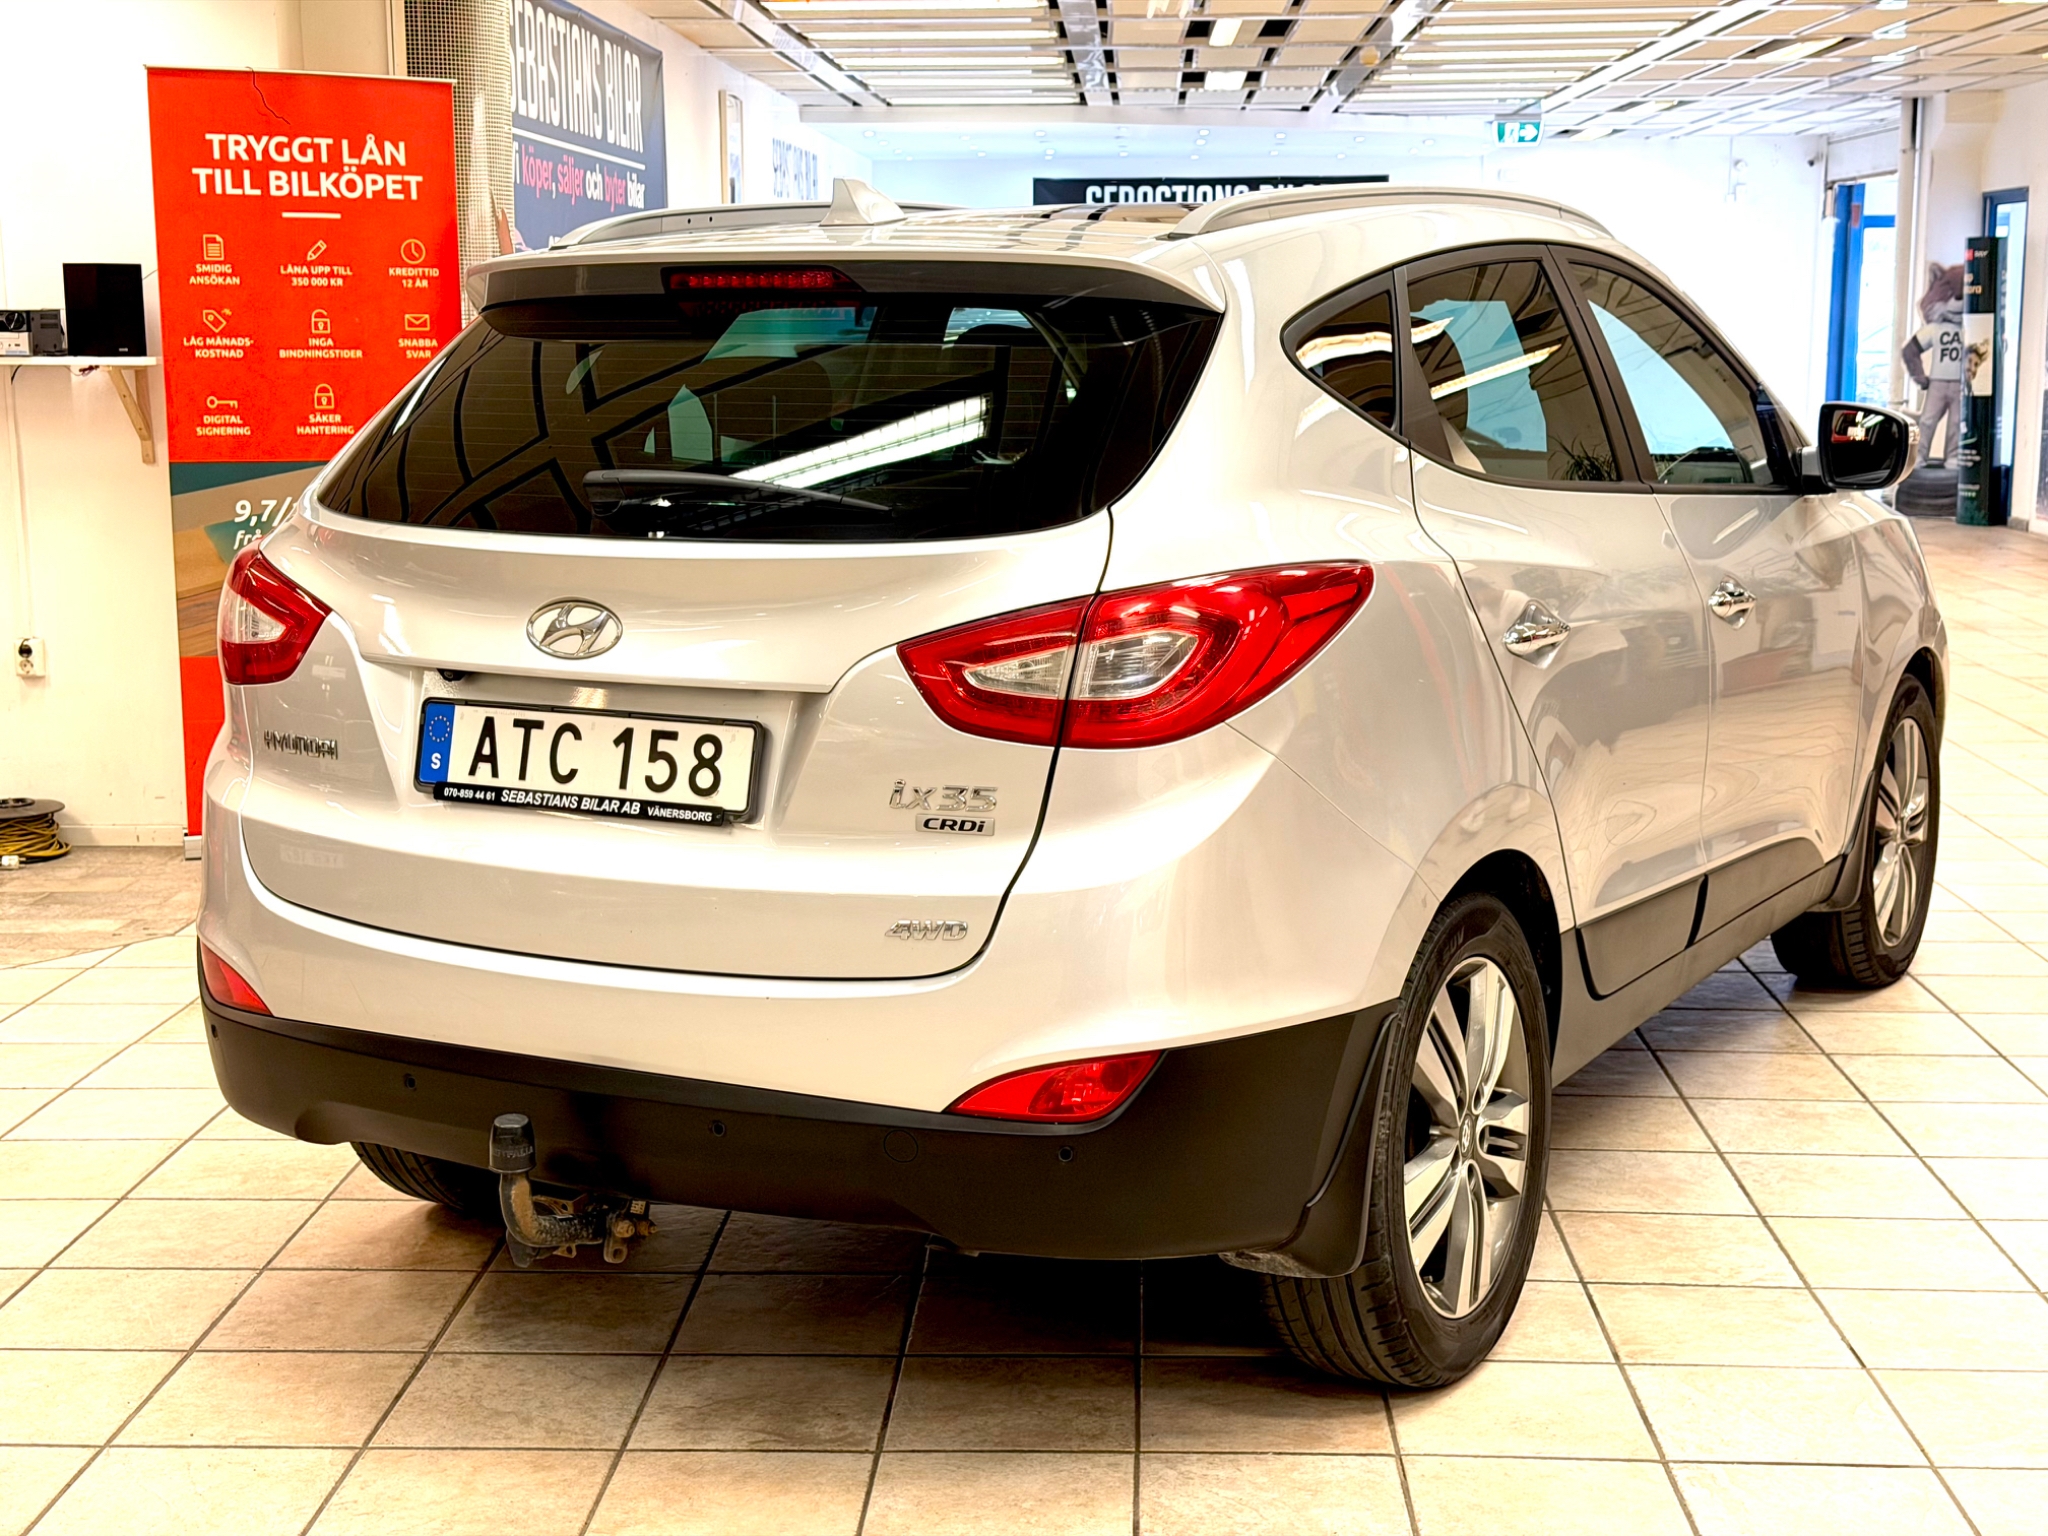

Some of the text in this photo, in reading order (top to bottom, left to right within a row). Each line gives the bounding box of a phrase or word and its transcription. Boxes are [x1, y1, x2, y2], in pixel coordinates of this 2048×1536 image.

[604, 39, 643, 153] BILAR
[205, 133, 406, 166] TRYGGT LÅN
[191, 165, 423, 200] TILL BILKÖPET
[522, 144, 556, 199] köper,
[557, 154, 584, 206] säljer
[586, 163, 603, 201] och
[604, 165, 626, 213] byter
[627, 171, 645, 209] bilar
[195, 264, 232, 273] SMIDIG
[280, 264, 353, 275] LÅNA UPP TILL
[389, 267, 439, 277] KREDITTID
[189, 274, 240, 285] ANSÖKAN
[291, 277, 343, 286] 350 000 KR
[402, 279, 429, 288] 12 ÅR
[183, 336, 254, 347] LÅG MÅNADS-
[308, 338, 333, 347] INGA
[398, 338, 438, 347] SNABBA
[195, 349, 243, 358] KOSTNAD
[279, 349, 363, 359] BINDNINGSTIDER
[406, 350, 431, 358] SVAR
[1940, 347, 1962, 363] FO
[203, 415, 243, 424] DIGITAL
[309, 413, 341, 423] SÄKER
[196, 427, 251, 436] SIGNERING
[296, 426, 354, 435] HANTERING
[263, 729, 339, 760] HYUNDAI
[430, 752, 441, 769] S
[467, 715, 723, 797] ATC 158
[889, 778, 998, 813] ix35
[444, 787, 712, 822] 070-859 44 61 SEBASTIANS BILAR AB VÄNERSBORG
[923, 817, 986, 832] CRDi
[885, 919, 968, 941] 4WD
